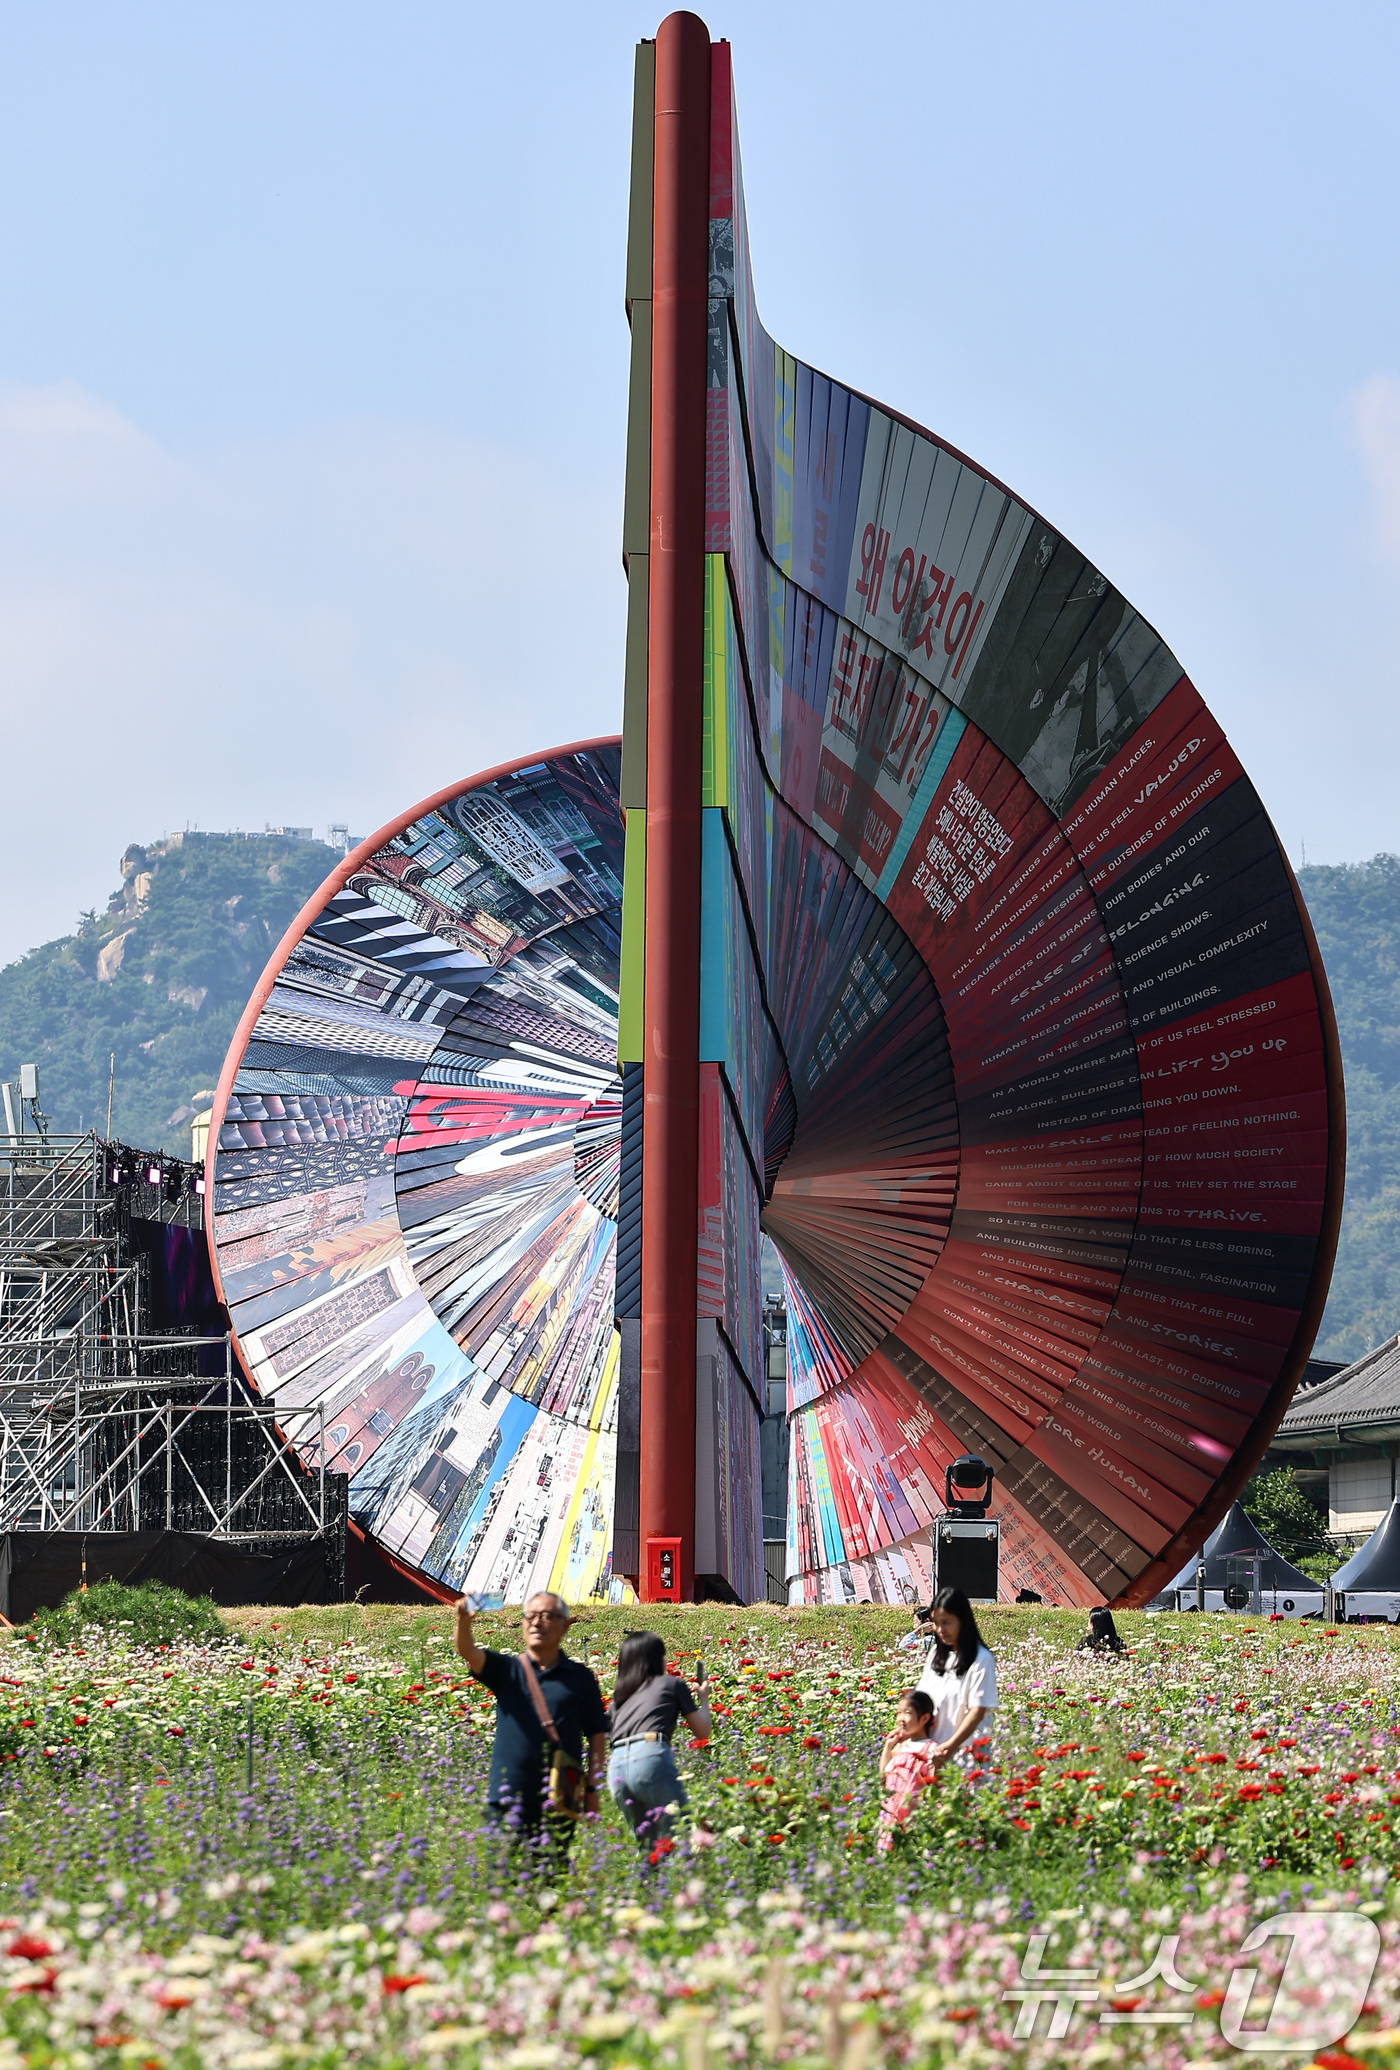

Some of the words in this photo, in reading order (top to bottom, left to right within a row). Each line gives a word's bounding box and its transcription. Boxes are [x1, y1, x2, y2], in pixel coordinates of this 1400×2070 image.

[856, 522, 890, 617] 왜
[892, 546, 984, 680] 이것이
[830, 632, 939, 784] 문제인가?
[935, 805, 956, 839] 5배나
[956, 831, 977, 861] 많은
[968, 846, 996, 884] 탄소를
[949, 778, 982, 823] 건설업이
[973, 808, 1014, 860] 항공업보다
[952, 958, 974, 979] FULL
[975, 942, 987, 956] OF
[990, 894, 1038, 942] BUILDINGS
[1040, 868, 1064, 892] THAT
[1066, 841, 1096, 868] MAKE
[1096, 828, 1110, 842] US
[1110, 806, 1134, 829] FEEL
[1134, 736, 1207, 804] VALUED.
[974, 896, 1007, 932] HUMAN
[1008, 857, 1040, 894] BEINGS
[1042, 814, 1085, 856] DESERVE
[1085, 778, 1118, 814] HUMAN
[1118, 738, 1156, 778] PLACES,
[911, 861, 930, 890] 알고
[926, 834, 957, 882] 배출한다는
[951, 867, 975, 902] 사실을
[958, 958, 1001, 996] BECAUSE
[1002, 935, 1026, 958] HOW
[1028, 920, 1046, 935] WE
[1047, 886, 1084, 919] DESIGN
[1086, 870, 1106, 887] THE
[1108, 830, 1154, 870] OUTSIDES
[1154, 816, 1168, 830] OF
[1169, 768, 1222, 819] BUILDINGS
[990, 959, 1034, 995] AFFECTS
[1036, 941, 1057, 960] OUR
[1106, 892, 1126, 910] OUR
[1128, 864, 1162, 894] BODIES
[1164, 846, 1186, 866] AND
[1188, 826, 1211, 846] OUR
[981, 1039, 1028, 1066] HUMANS
[1031, 1024, 1060, 1040] NEED
[1064, 990, 1128, 1024] ORNAMENT
[1132, 978, 1154, 994] AND
[1157, 960, 1196, 982] VISUAL
[1198, 920, 1268, 962] COMPLEXITY
[1010, 964, 1064, 1006] SENSE
[1071, 942, 1093, 964] OF
[1020, 1004, 1046, 1022] THAT
[1050, 996, 1060, 1006] IS
[1064, 975, 1094, 997] WHAT
[1098, 962, 1122, 976] THE
[1125, 936, 1168, 966] SCIENCE
[1170, 911, 1213, 939] SHOWS.
[992, 1090, 1004, 1098] IN
[1018, 1072, 1060, 1090] WORLD
[1064, 1057, 1106, 1074] WHERE
[1110, 1042, 1147, 1060] MANY
[1150, 1036, 1164, 1048] OF
[1168, 1031, 1183, 1042] US
[1186, 1021, 1214, 1036] FEEL
[1217, 1000, 1277, 1026] STRESSED
[1038, 1052, 1054, 1062] ON
[1057, 1041, 1080, 1054] THE
[1142, 1011, 1157, 1022] OF
[1160, 984, 1222, 1016] BUILDINGS.
[985, 1147, 1018, 1155] MAKE
[1119, 1126, 1170, 1140] INSTEAD
[1174, 1125, 1188, 1134] OF
[1192, 1118, 1240, 1131] FEELING
[1244, 1110, 1300, 1125] NOTHING.
[988, 1108, 1012, 1119] AND
[1062, 1080, 1125, 1101] BUILDINGS
[1038, 1114, 1087, 1128] INSTEAD
[1091, 1110, 1106, 1118] OF
[1176, 1092, 1198, 1104] YOU
[1202, 1084, 1242, 1099] DOWN.
[1001, 1162, 1062, 1170] BUILDINGS
[1102, 1156, 1142, 1164] SPEAK
[1166, 1153, 1192, 1162] HOW
[1196, 1151, 1230, 1160] MUCH
[1234, 1148, 1284, 1157] SOCIETY
[1259, 1180, 1298, 1189] STAGE
[1032, 1202, 1077, 1210] PEOPLE
[1042, 1224, 1085, 1234] CREATE
[1150, 1235, 1178, 1244] THAT
[1195, 1241, 1224, 1251] LESS
[1228, 1244, 1275, 1258] BORING,
[976, 1232, 1000, 1242] AND
[1004, 1238, 1064, 1254] BUILDINGS
[1068, 1250, 1118, 1263] INFUSED
[1156, 1264, 1196, 1279] DETAIL,
[1200, 1272, 1276, 1293] FASCINATION
[980, 1252, 1004, 1262] AND
[1008, 1258, 1056, 1275] DELIGHT.
[1094, 1280, 1130, 1294] MAKE
[1134, 1289, 1166, 1304] CITIES
[1170, 1298, 1198, 1311] THAT
[1200, 1306, 1223, 1318] ARE
[1226, 1312, 1254, 1326] FULL
[952, 1278, 978, 1292] THAT
[1004, 1301, 1034, 1316] BUILT
[1071, 1328, 1108, 1342] LOVED
[1192, 1374, 1241, 1398] COPYING
[994, 1316, 1020, 1332] PAST
[1046, 1340, 1102, 1368] REACHING
[1149, 1387, 1191, 1412] FUTURE.
[943, 1308, 973, 1327] DON'T
[995, 1338, 1038, 1365] ANYONE
[1040, 1362, 1064, 1380] TELL
[1092, 1388, 1114, 1404] THIS
[1116, 1402, 1142, 1420] ISN'T
[1144, 1418, 1196, 1451] POSSIBLE.
[1008, 1370, 1030, 1385] CAN
[1032, 1384, 1064, 1404] MAKE
[1066, 1402, 1085, 1418] OUR
[1087, 1414, 1122, 1441] WORLD
[662, 1553, 672, 1588] 소화기
